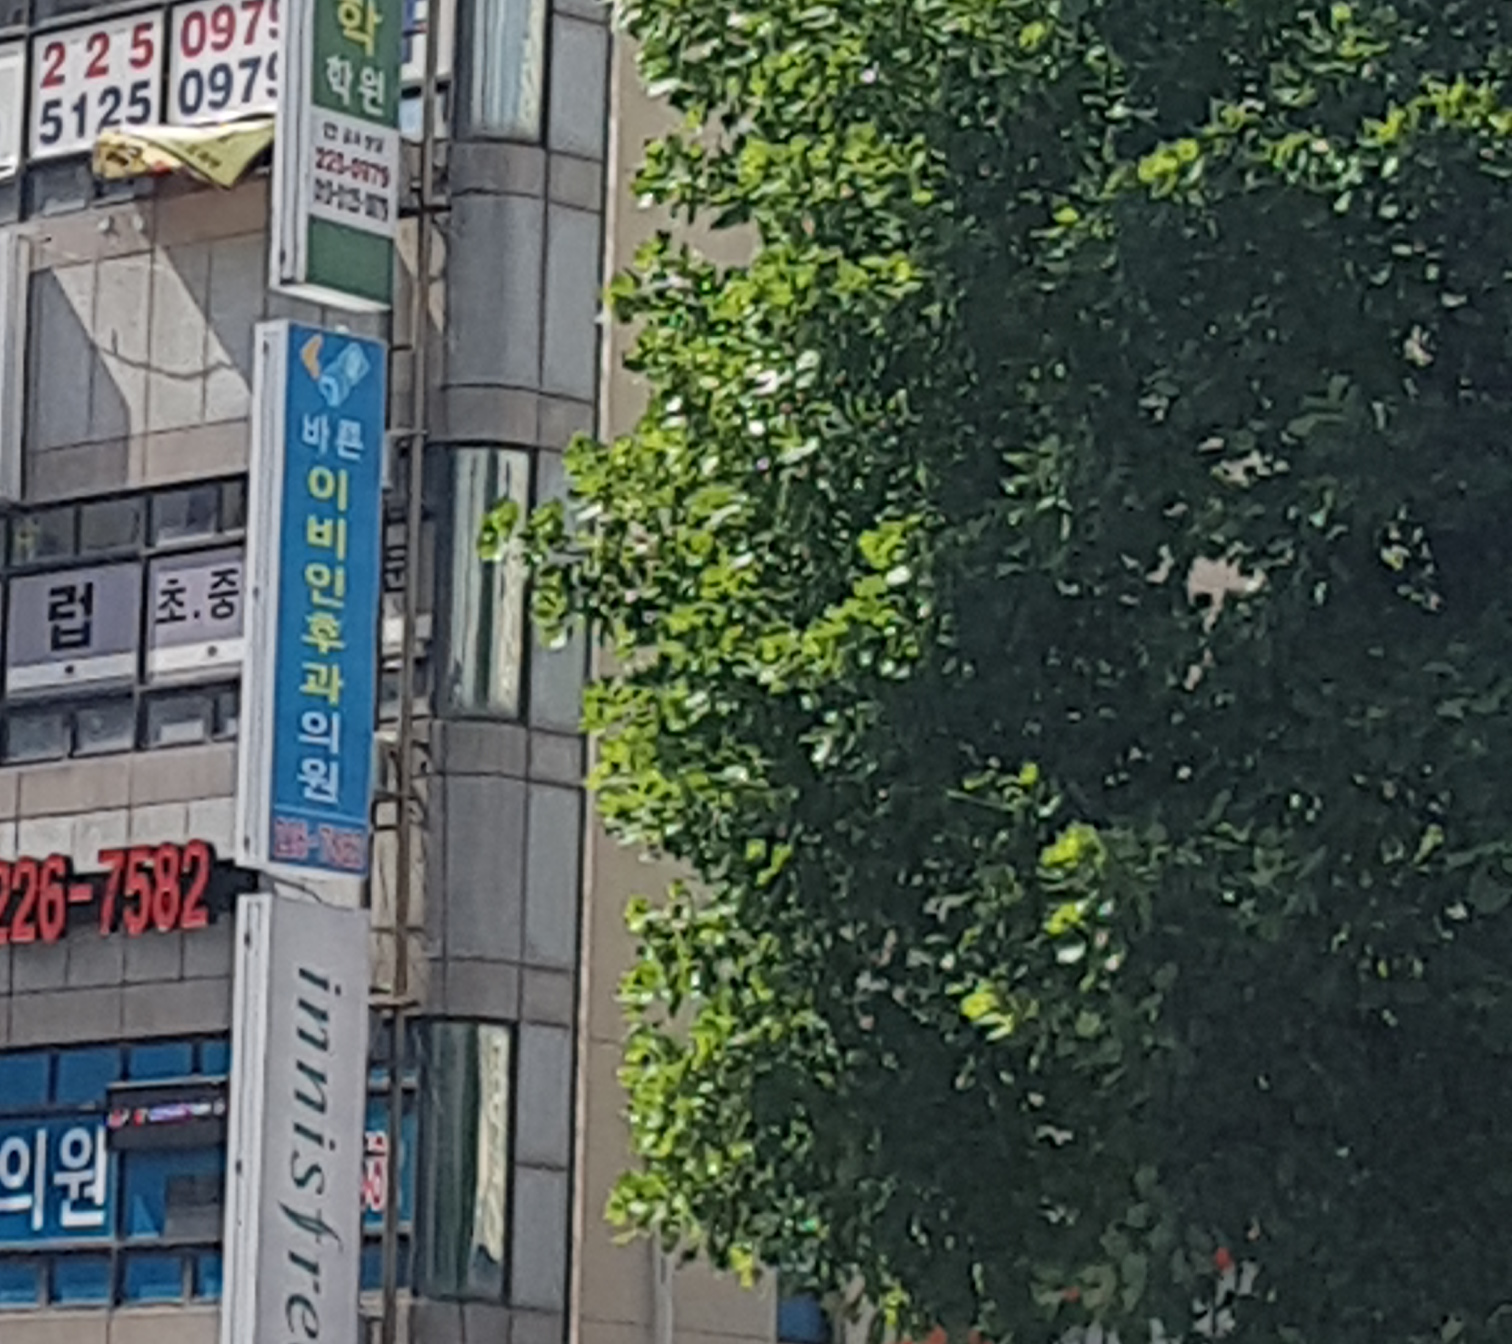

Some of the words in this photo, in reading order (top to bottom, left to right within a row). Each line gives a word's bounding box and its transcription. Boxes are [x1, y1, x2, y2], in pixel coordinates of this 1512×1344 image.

[40, 22, 156, 90] 225
[326, 55, 386, 117] 학원
[39, 80, 152, 147] 5125
[300, 412, 365, 461] 바른
[299, 464, 348, 706] 이비인후과
[295, 708, 342, 806] 의원
